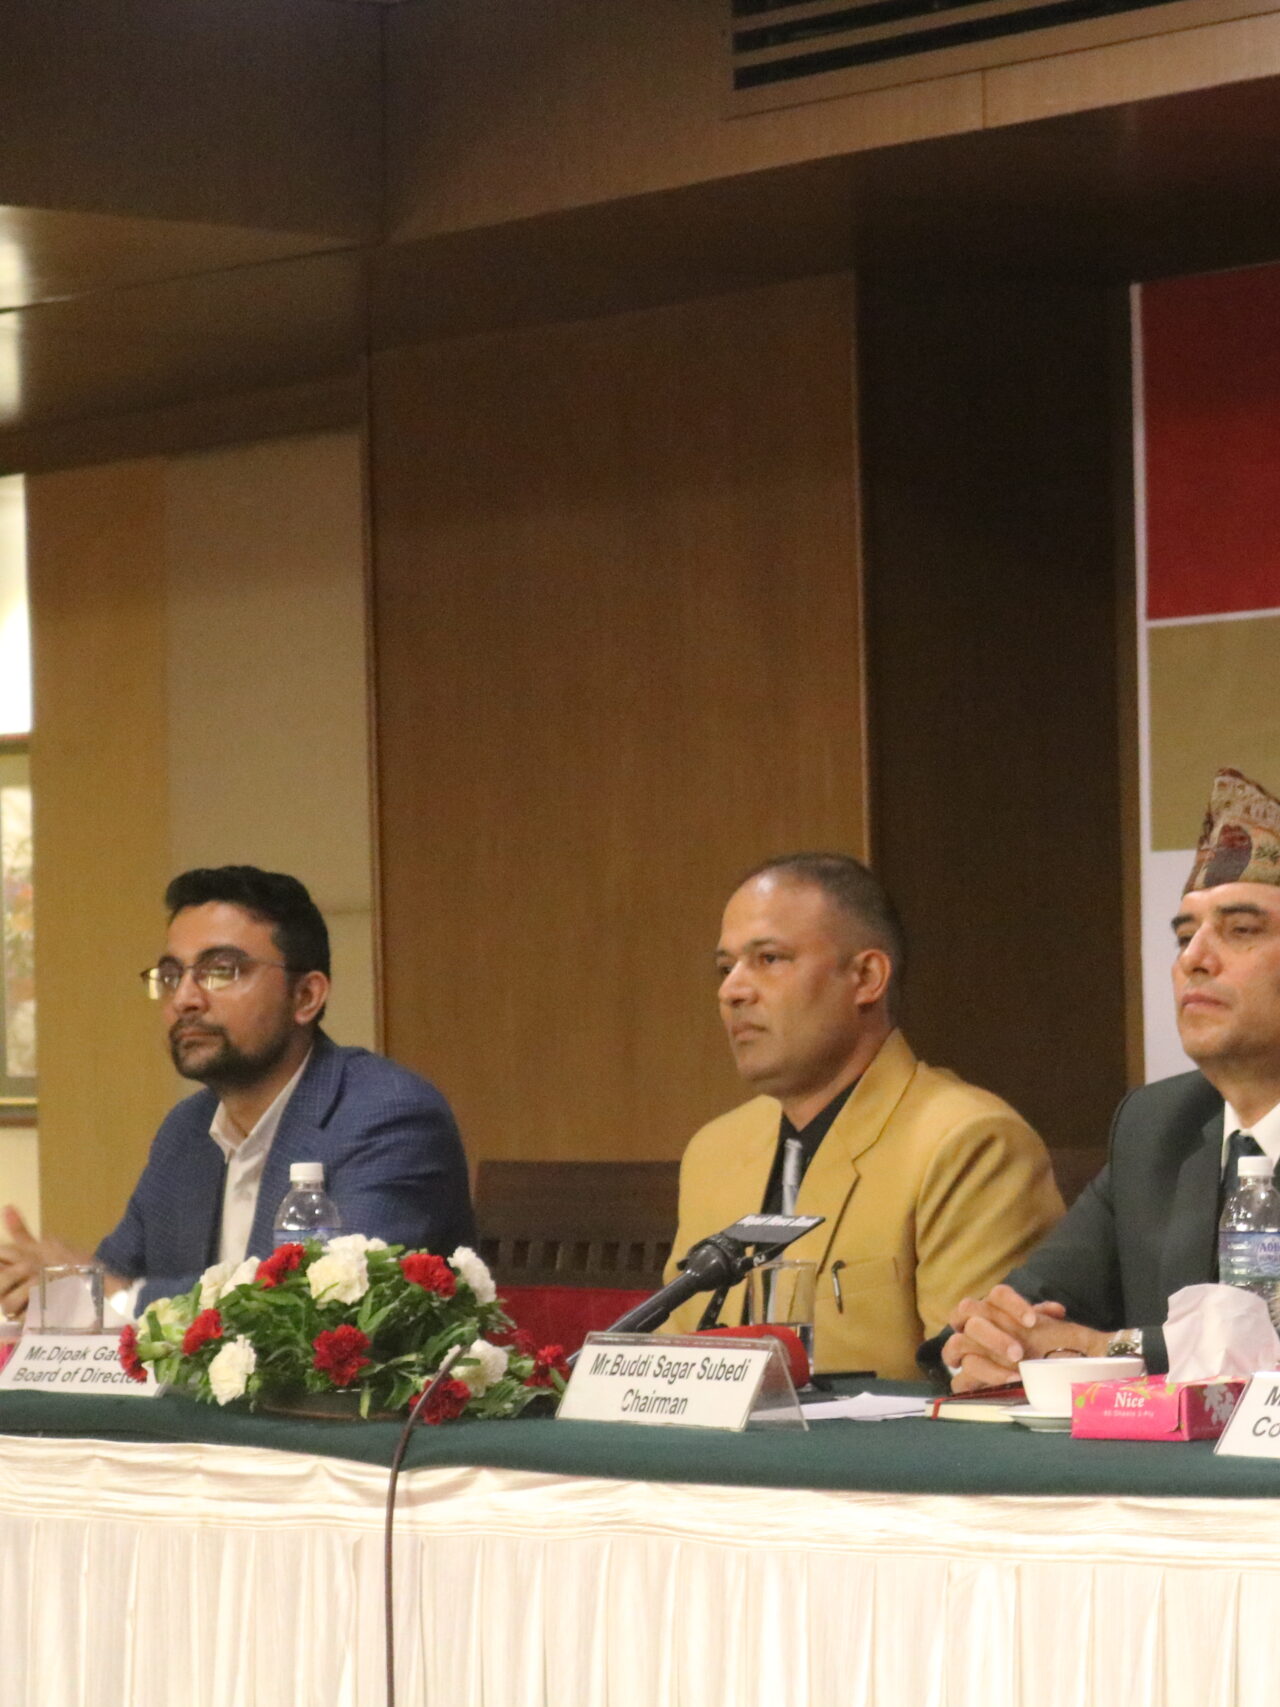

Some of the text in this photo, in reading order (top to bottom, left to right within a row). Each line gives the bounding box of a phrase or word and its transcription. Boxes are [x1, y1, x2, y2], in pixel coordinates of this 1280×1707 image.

[12, 1368, 59, 1383] Board
[61, 1368, 78, 1383] of
[653, 1355, 696, 1385] Sagar
[697, 1357, 751, 1382] Subedi
[620, 1388, 688, 1415] Chairman
[1113, 1391, 1145, 1408] Nice
